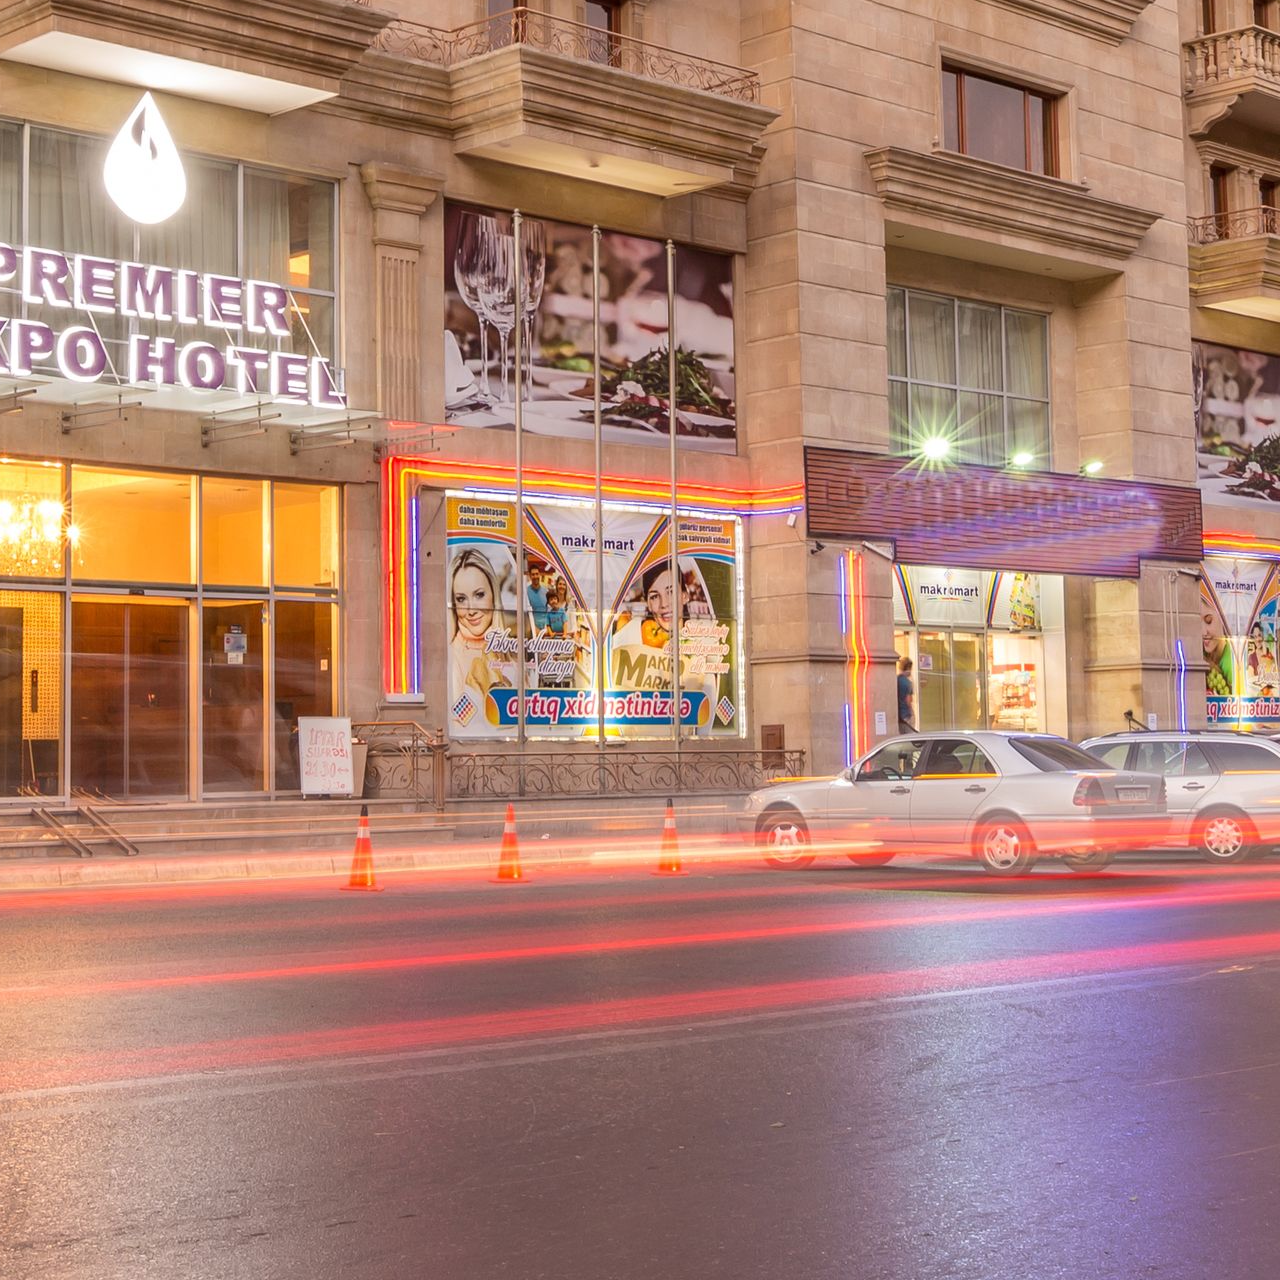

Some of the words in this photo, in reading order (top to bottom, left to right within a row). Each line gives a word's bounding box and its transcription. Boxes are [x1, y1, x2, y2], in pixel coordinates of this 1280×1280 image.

[129, 334, 348, 410] HOTEL
[561, 535, 635, 551] makrmart
[507, 692, 559, 723] artıq
[563, 690, 692, 718] xidmətinizə
